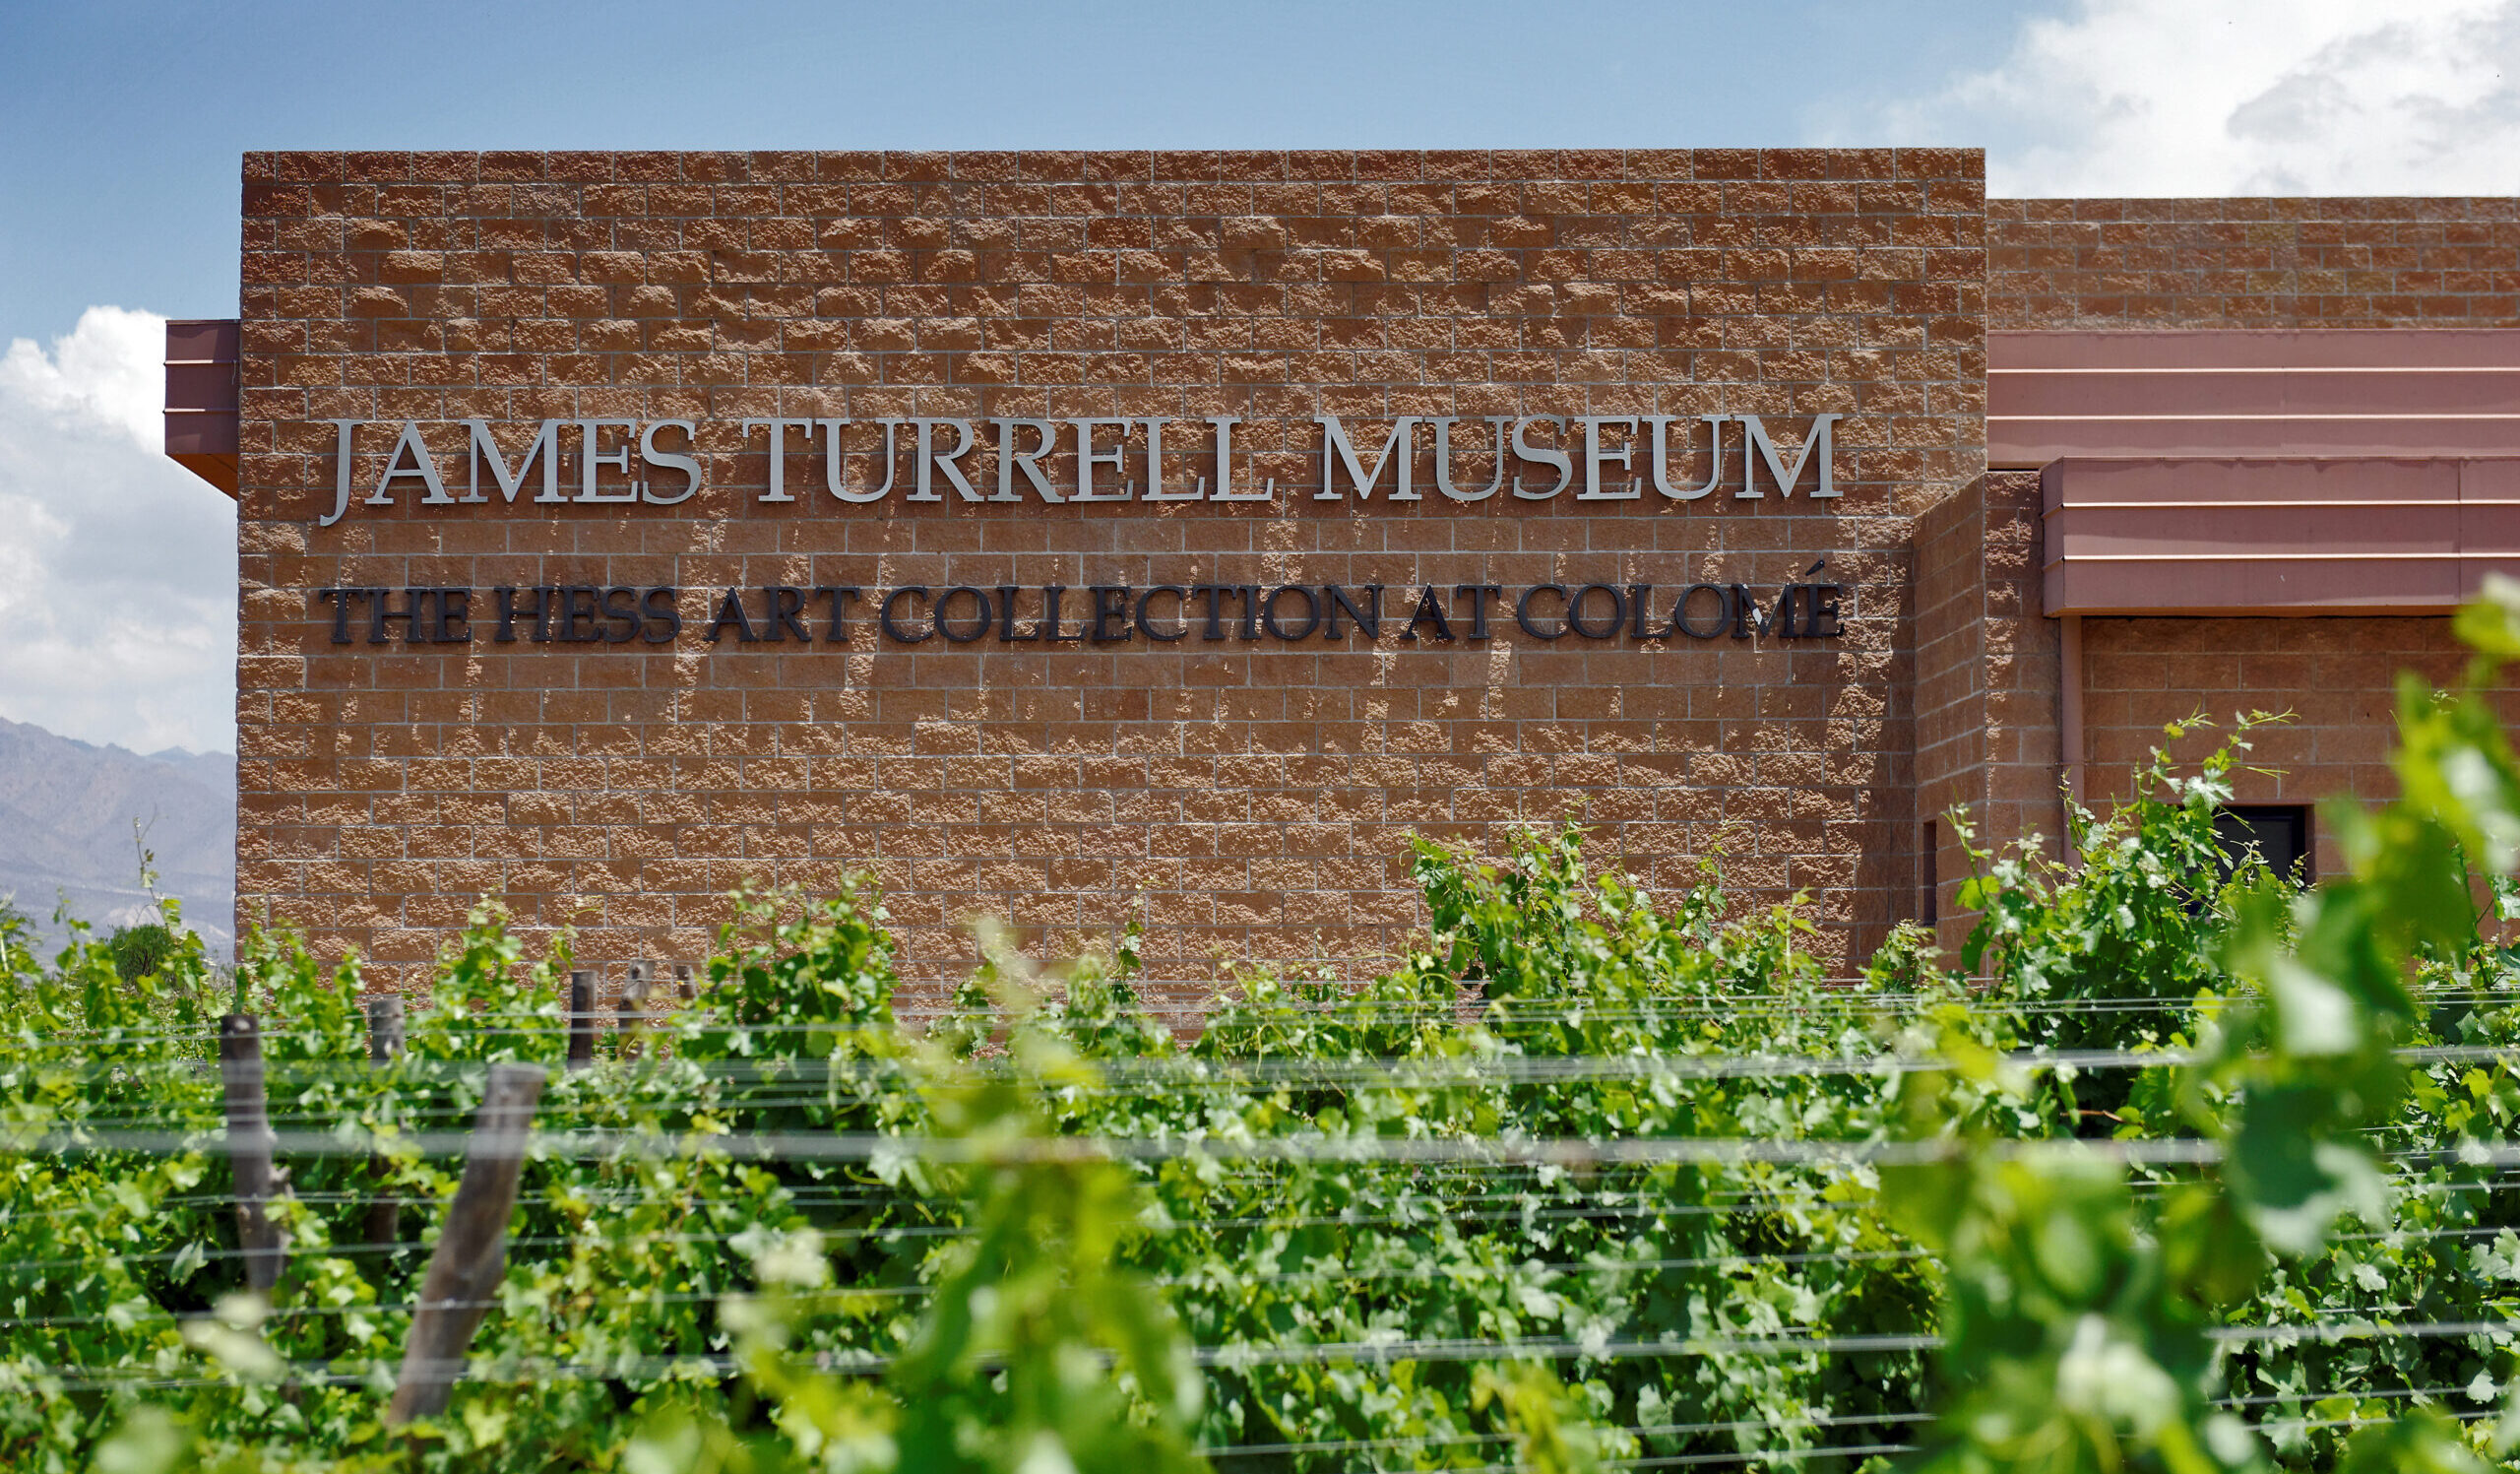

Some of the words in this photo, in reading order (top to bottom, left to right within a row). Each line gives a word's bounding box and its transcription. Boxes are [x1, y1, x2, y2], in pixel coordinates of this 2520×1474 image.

[319, 417, 704, 527] JAMES
[741, 416, 1274, 505] TURRELL
[1313, 413, 1844, 502] MUSEUM
[319, 586, 472, 644] THE
[494, 585, 683, 644] HESS
[703, 586, 861, 644] ART
[881, 583, 1384, 644] COLLECTION
[1402, 583, 1502, 641] AT
[1516, 559, 1846, 641] COLOMÉ
